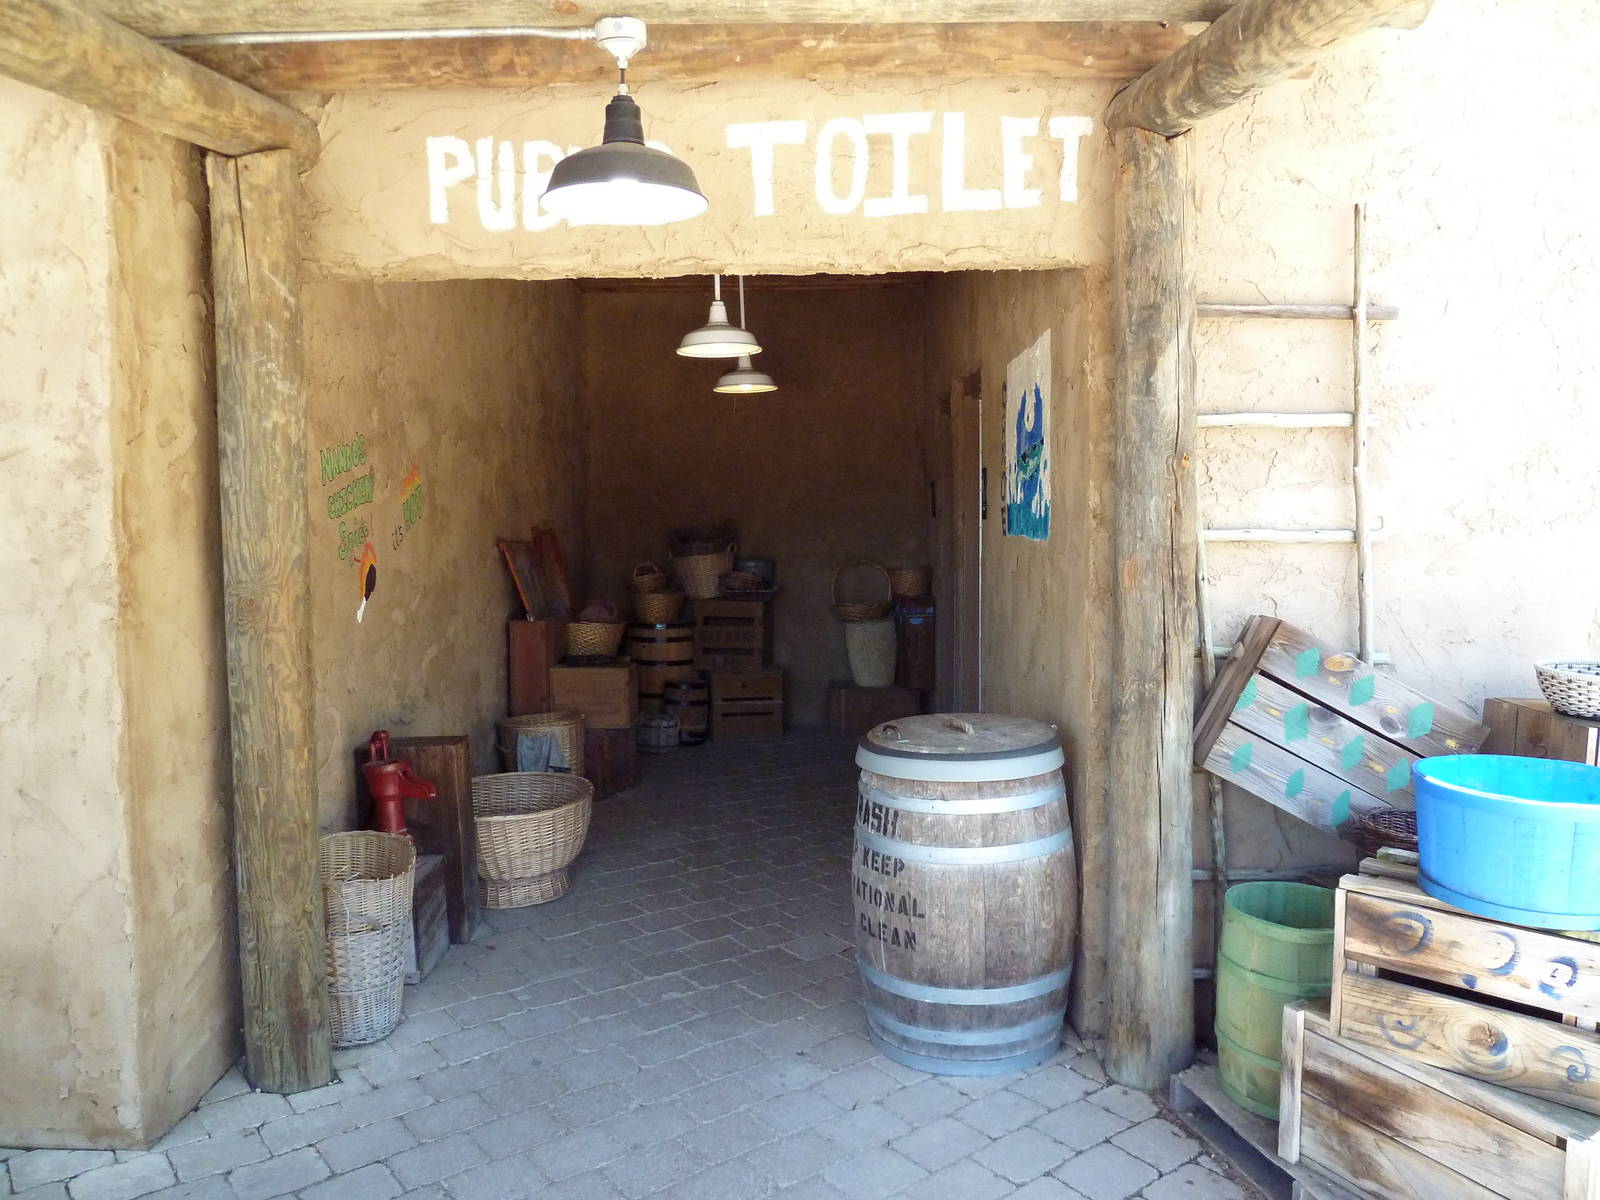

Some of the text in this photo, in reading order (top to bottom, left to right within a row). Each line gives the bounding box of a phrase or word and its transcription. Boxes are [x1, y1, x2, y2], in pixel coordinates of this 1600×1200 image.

[426, 111, 1094, 233] PUB TOILET
[862, 846, 905, 878] KEEP
[860, 912, 917, 951] CLEAN
